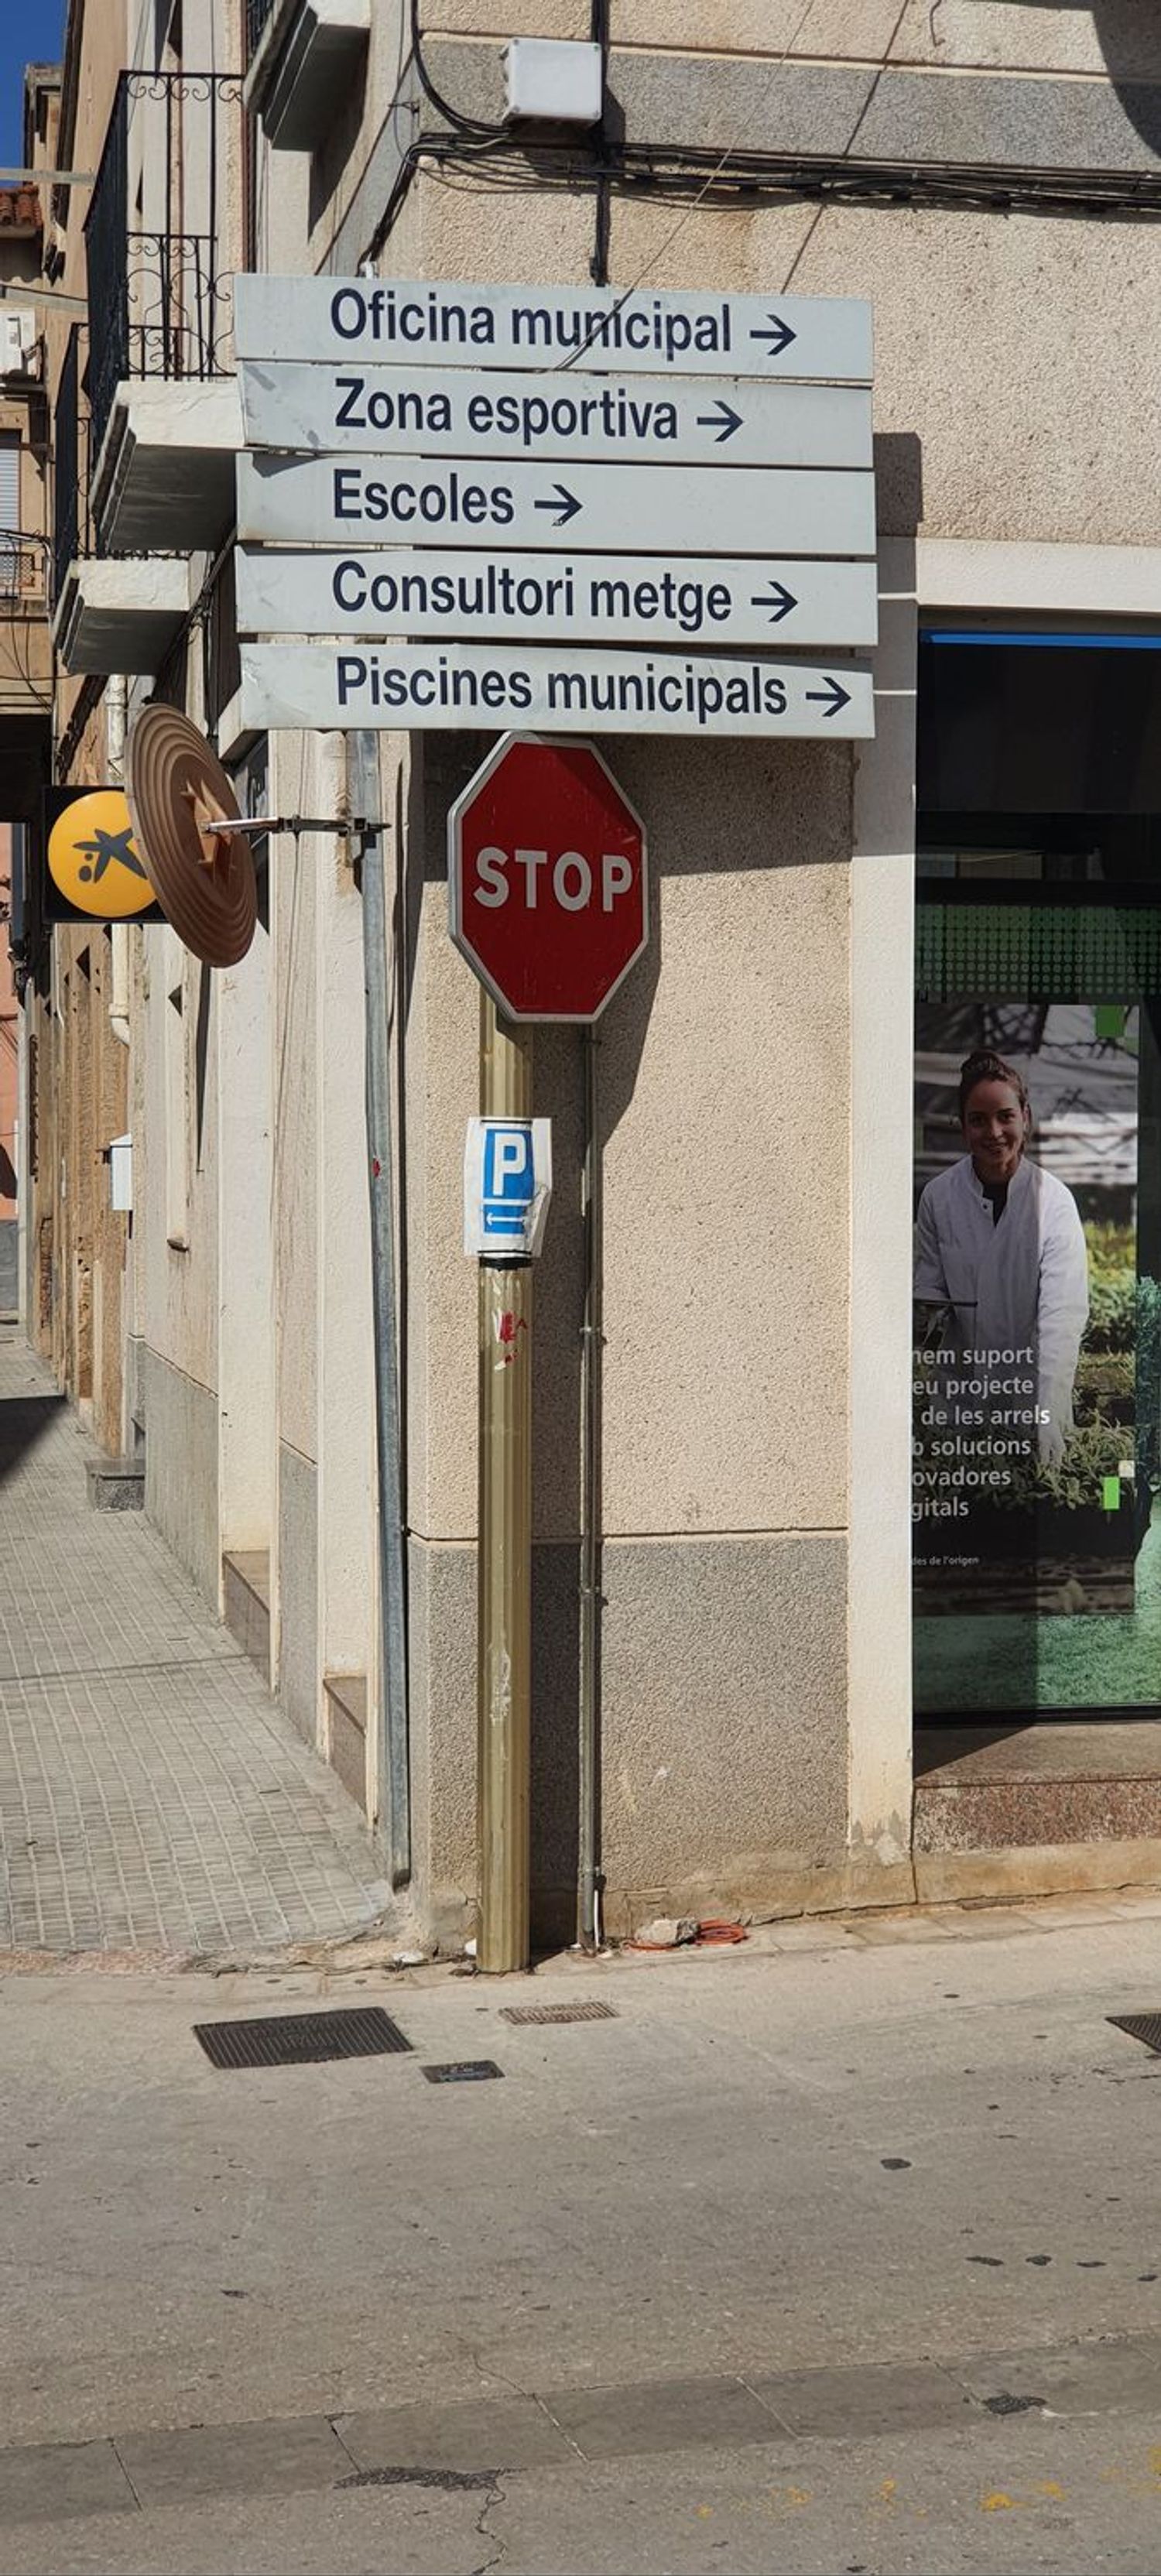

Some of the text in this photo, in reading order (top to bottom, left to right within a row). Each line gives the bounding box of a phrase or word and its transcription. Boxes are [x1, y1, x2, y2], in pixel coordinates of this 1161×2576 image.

[330, 288, 731, 361] Oficina municipal
[335, 378, 677, 446] Zona esportiva
[334, 469, 514, 525] Escoles
[333, 560, 732, 632] Consultori metge
[337, 656, 788, 724] Piscines municipals
[473, 846, 633, 912] STOP
[492, 1132, 527, 1196] P
[962, 1346, 1034, 1369] suport
[921, 1404, 1051, 1425] de les arrels
[946, 1374, 1034, 1399] projecte
[931, 1435, 1032, 1456] solucions
[913, 1466, 1012, 1486] ovadores
[912, 1496, 969, 1522] gitals
